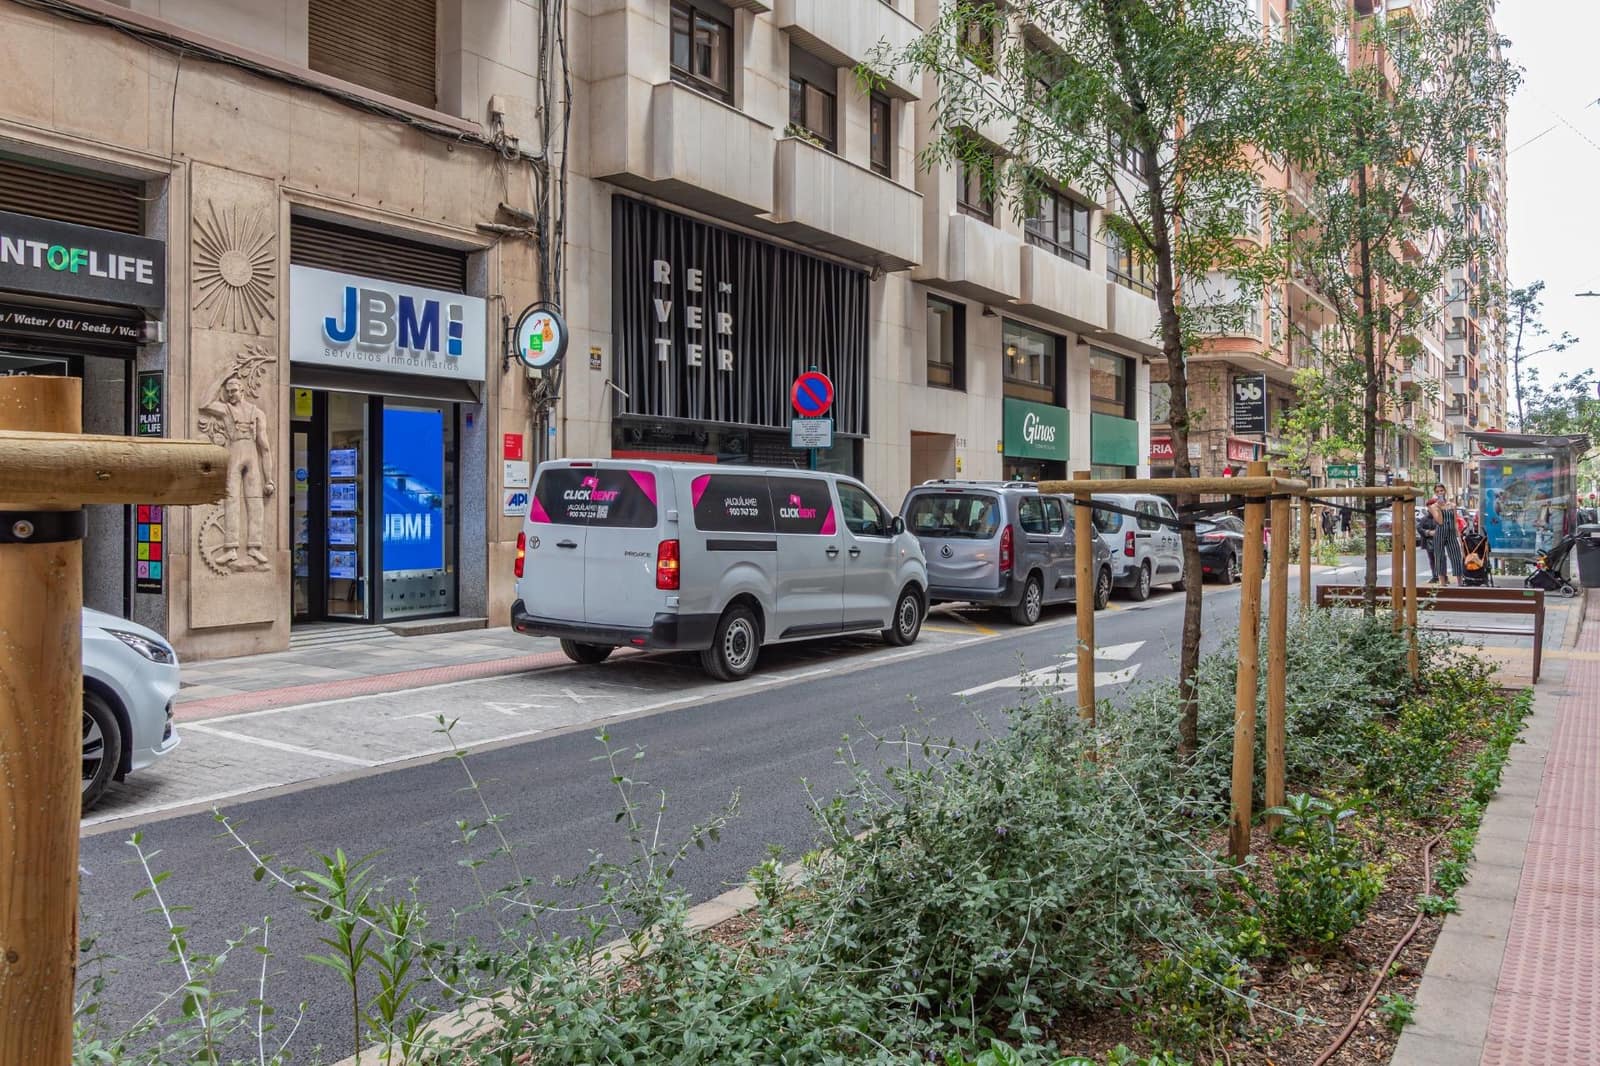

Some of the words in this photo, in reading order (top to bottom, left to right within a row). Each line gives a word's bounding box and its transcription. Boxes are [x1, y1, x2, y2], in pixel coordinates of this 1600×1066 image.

[14, 313, 48, 327] Water
[56, 319, 73, 330] Oil
[81, 322, 111, 334] Seeds
[324, 348, 382, 363] servicios
[386, 356, 460, 371] inmobiliarios
[139, 414, 161, 424] PLANT
[1023, 412, 1056, 444] Ginos
